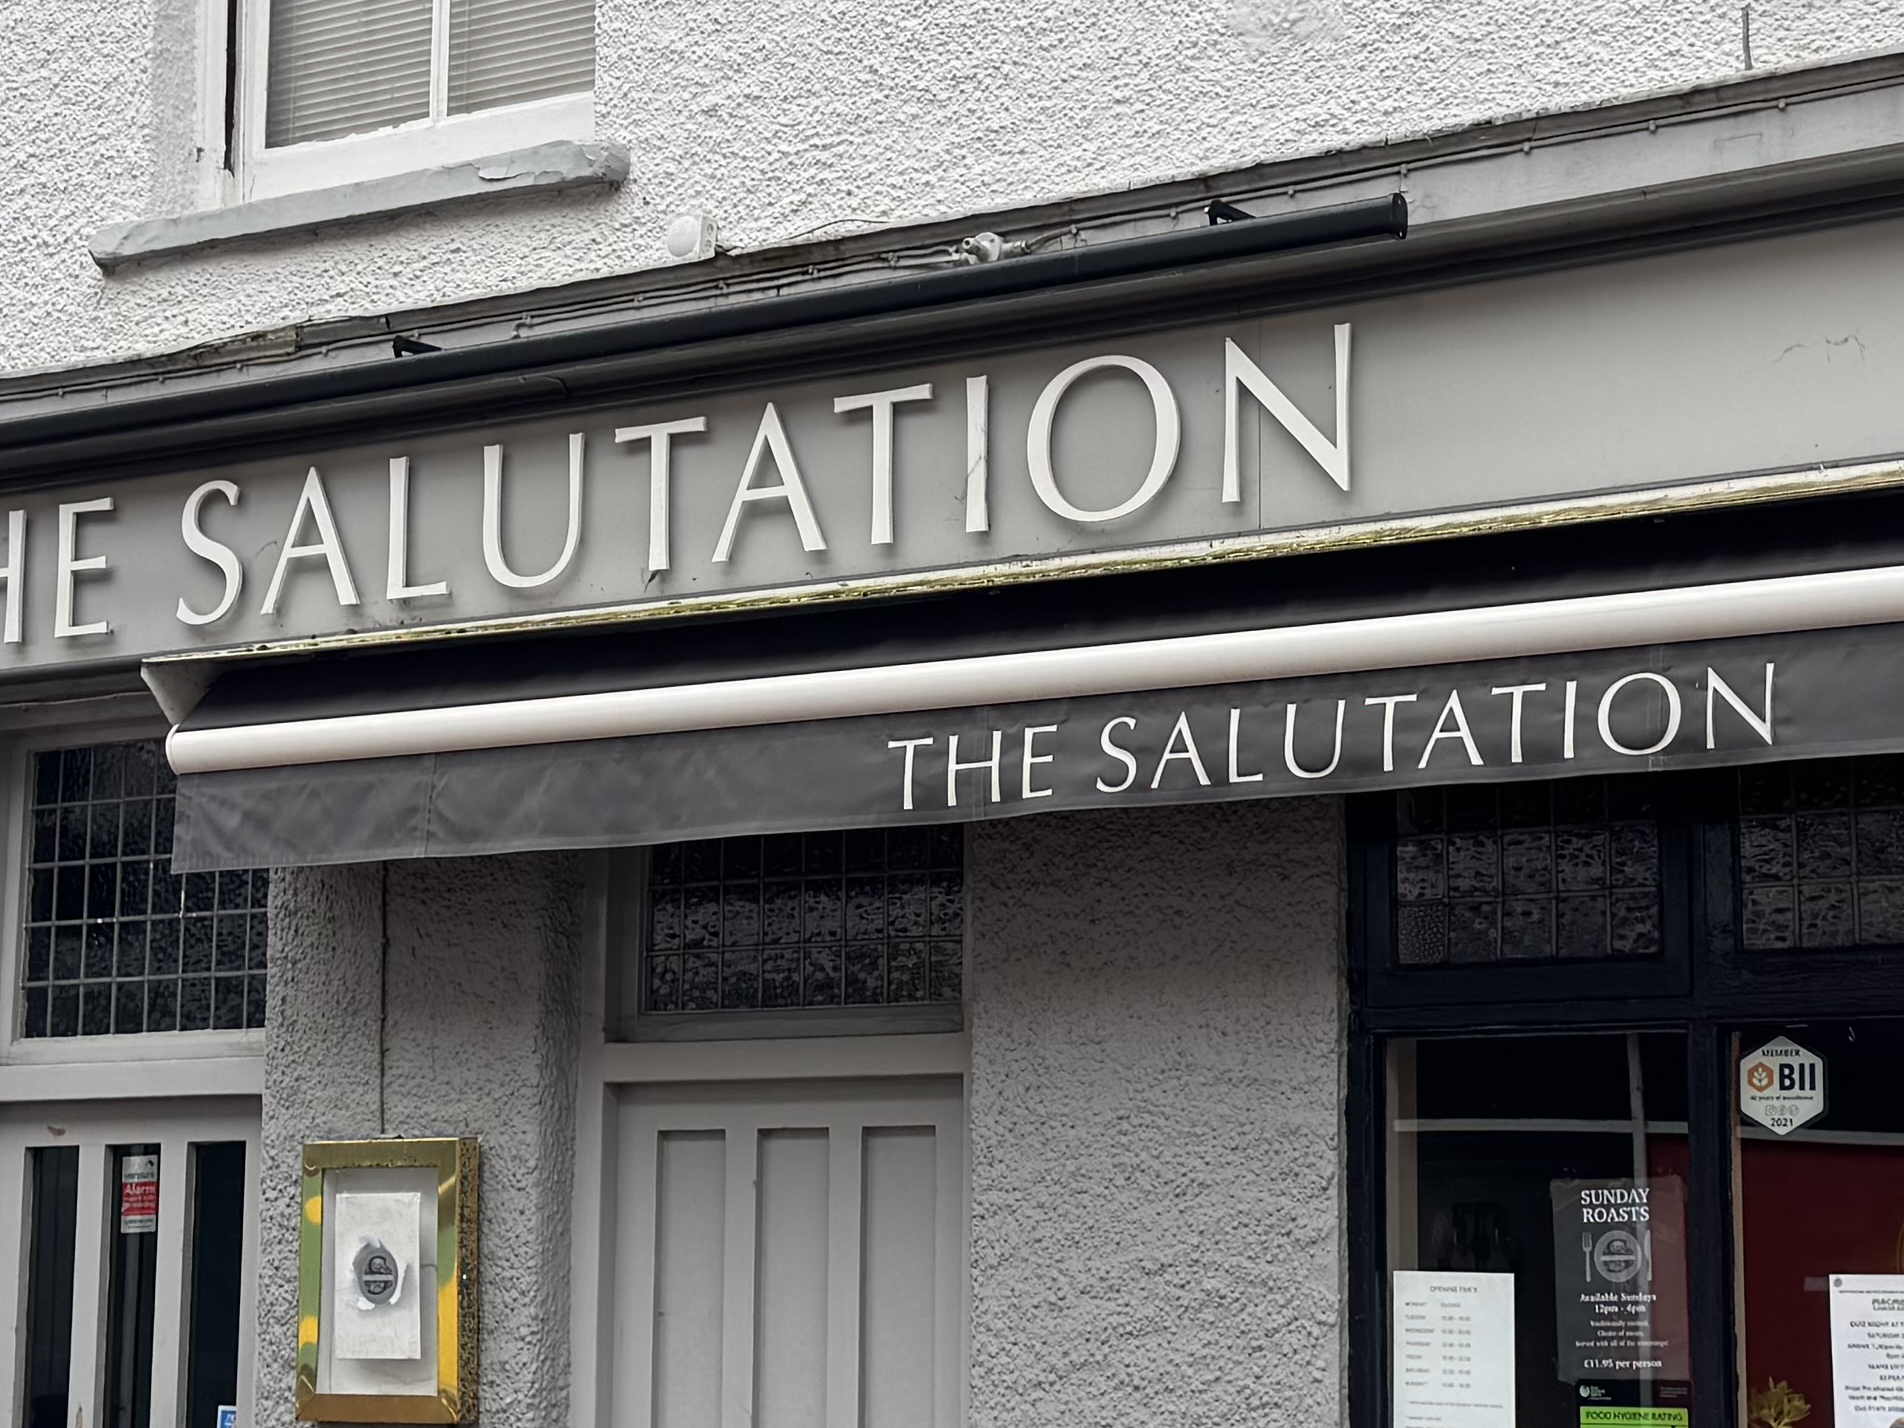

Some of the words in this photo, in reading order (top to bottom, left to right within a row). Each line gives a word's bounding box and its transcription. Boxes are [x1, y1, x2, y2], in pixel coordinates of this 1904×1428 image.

[176, 322, 1352, 625] SALUTATION
[887, 724, 1058, 811] THE
[1096, 662, 1776, 795] SALUTATION
[1779, 1063, 1816, 1091] BII
[1770, 1118, 1794, 1127] 2021
[1581, 1188, 1650, 1205] SUNDAY
[1583, 1206, 1650, 1223] ROASTS
[1615, 1360, 1630, 1370] per
[1585, 1411, 1612, 1420] FOOD
